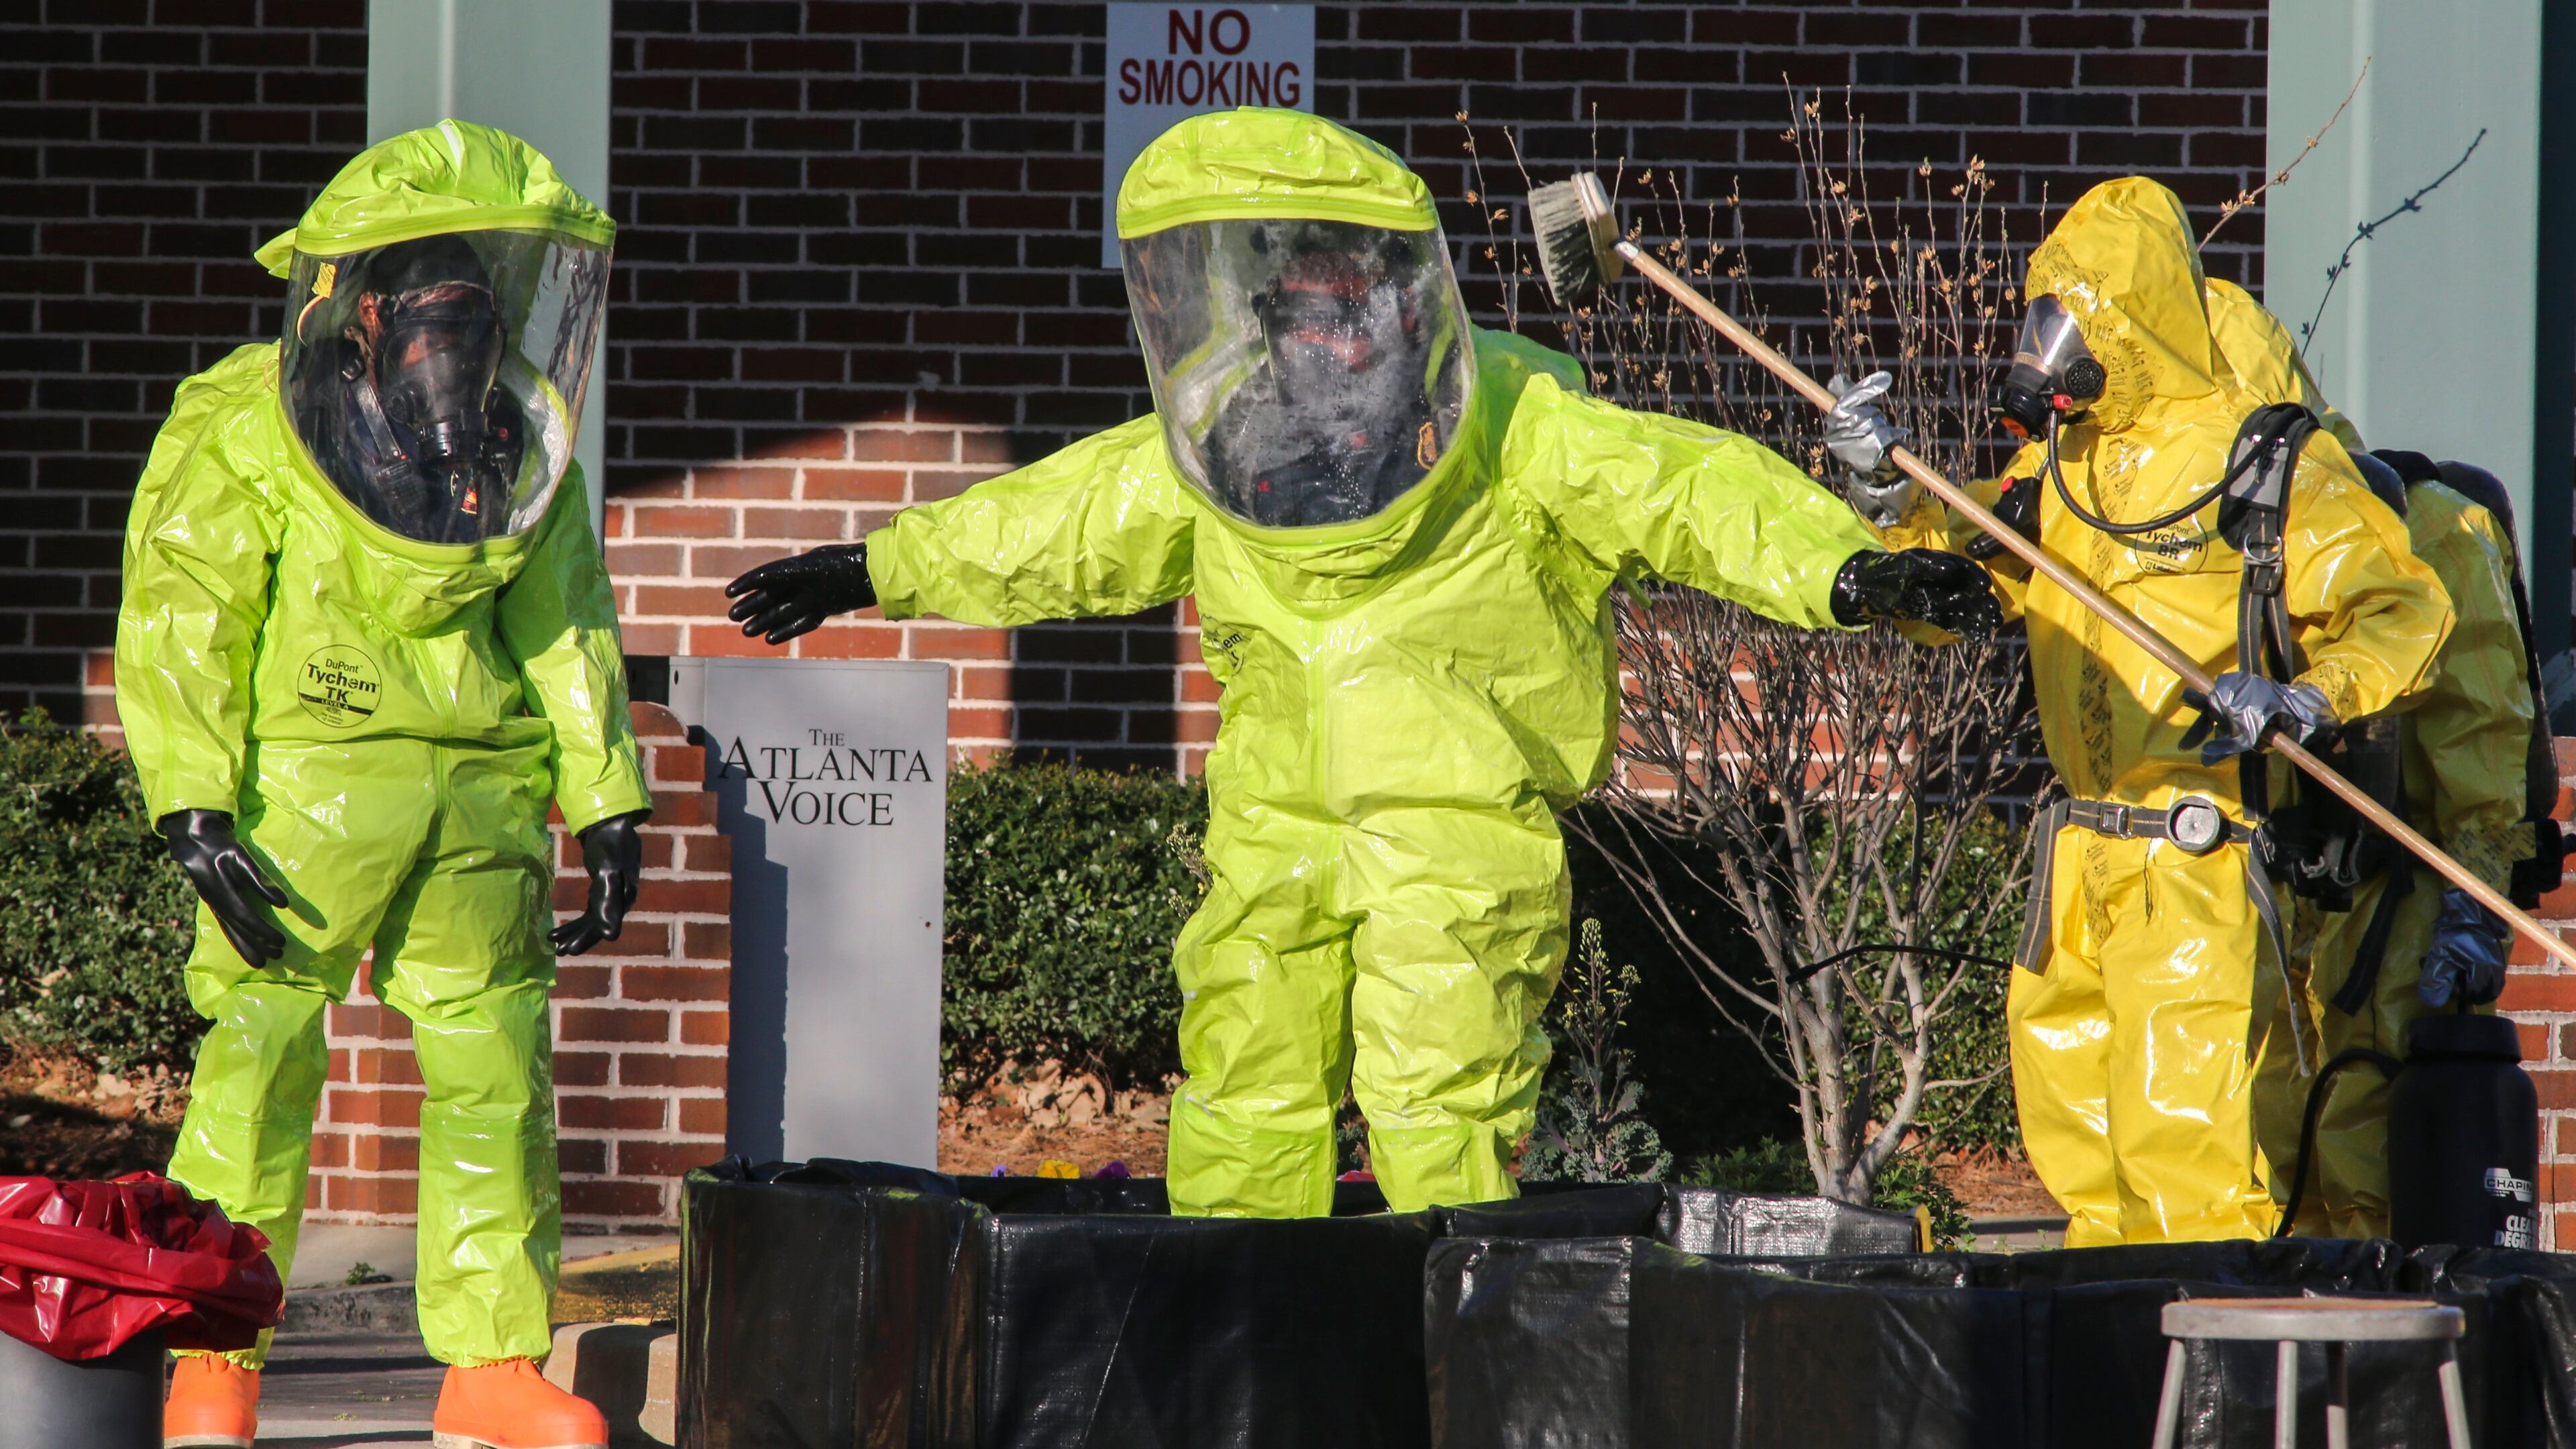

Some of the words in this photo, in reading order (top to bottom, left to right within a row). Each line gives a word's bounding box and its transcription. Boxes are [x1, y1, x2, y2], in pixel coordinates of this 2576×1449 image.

[1169, 9, 1250, 56] NO
[1118, 58, 1300, 107] SMOKING
[2167, 523, 2190, 535] uPont
[2157, 544, 2180, 560] BR
[325, 658, 360, 673] DuPont
[307, 663, 376, 693] Tychem
[325, 686, 350, 703] TK
[718, 736, 933, 782] ATLANTA
[757, 781, 894, 826] VOICE
[2487, 1178, 2532, 1193] CHAPIN
[2506, 1215, 2537, 1234] CLEA
